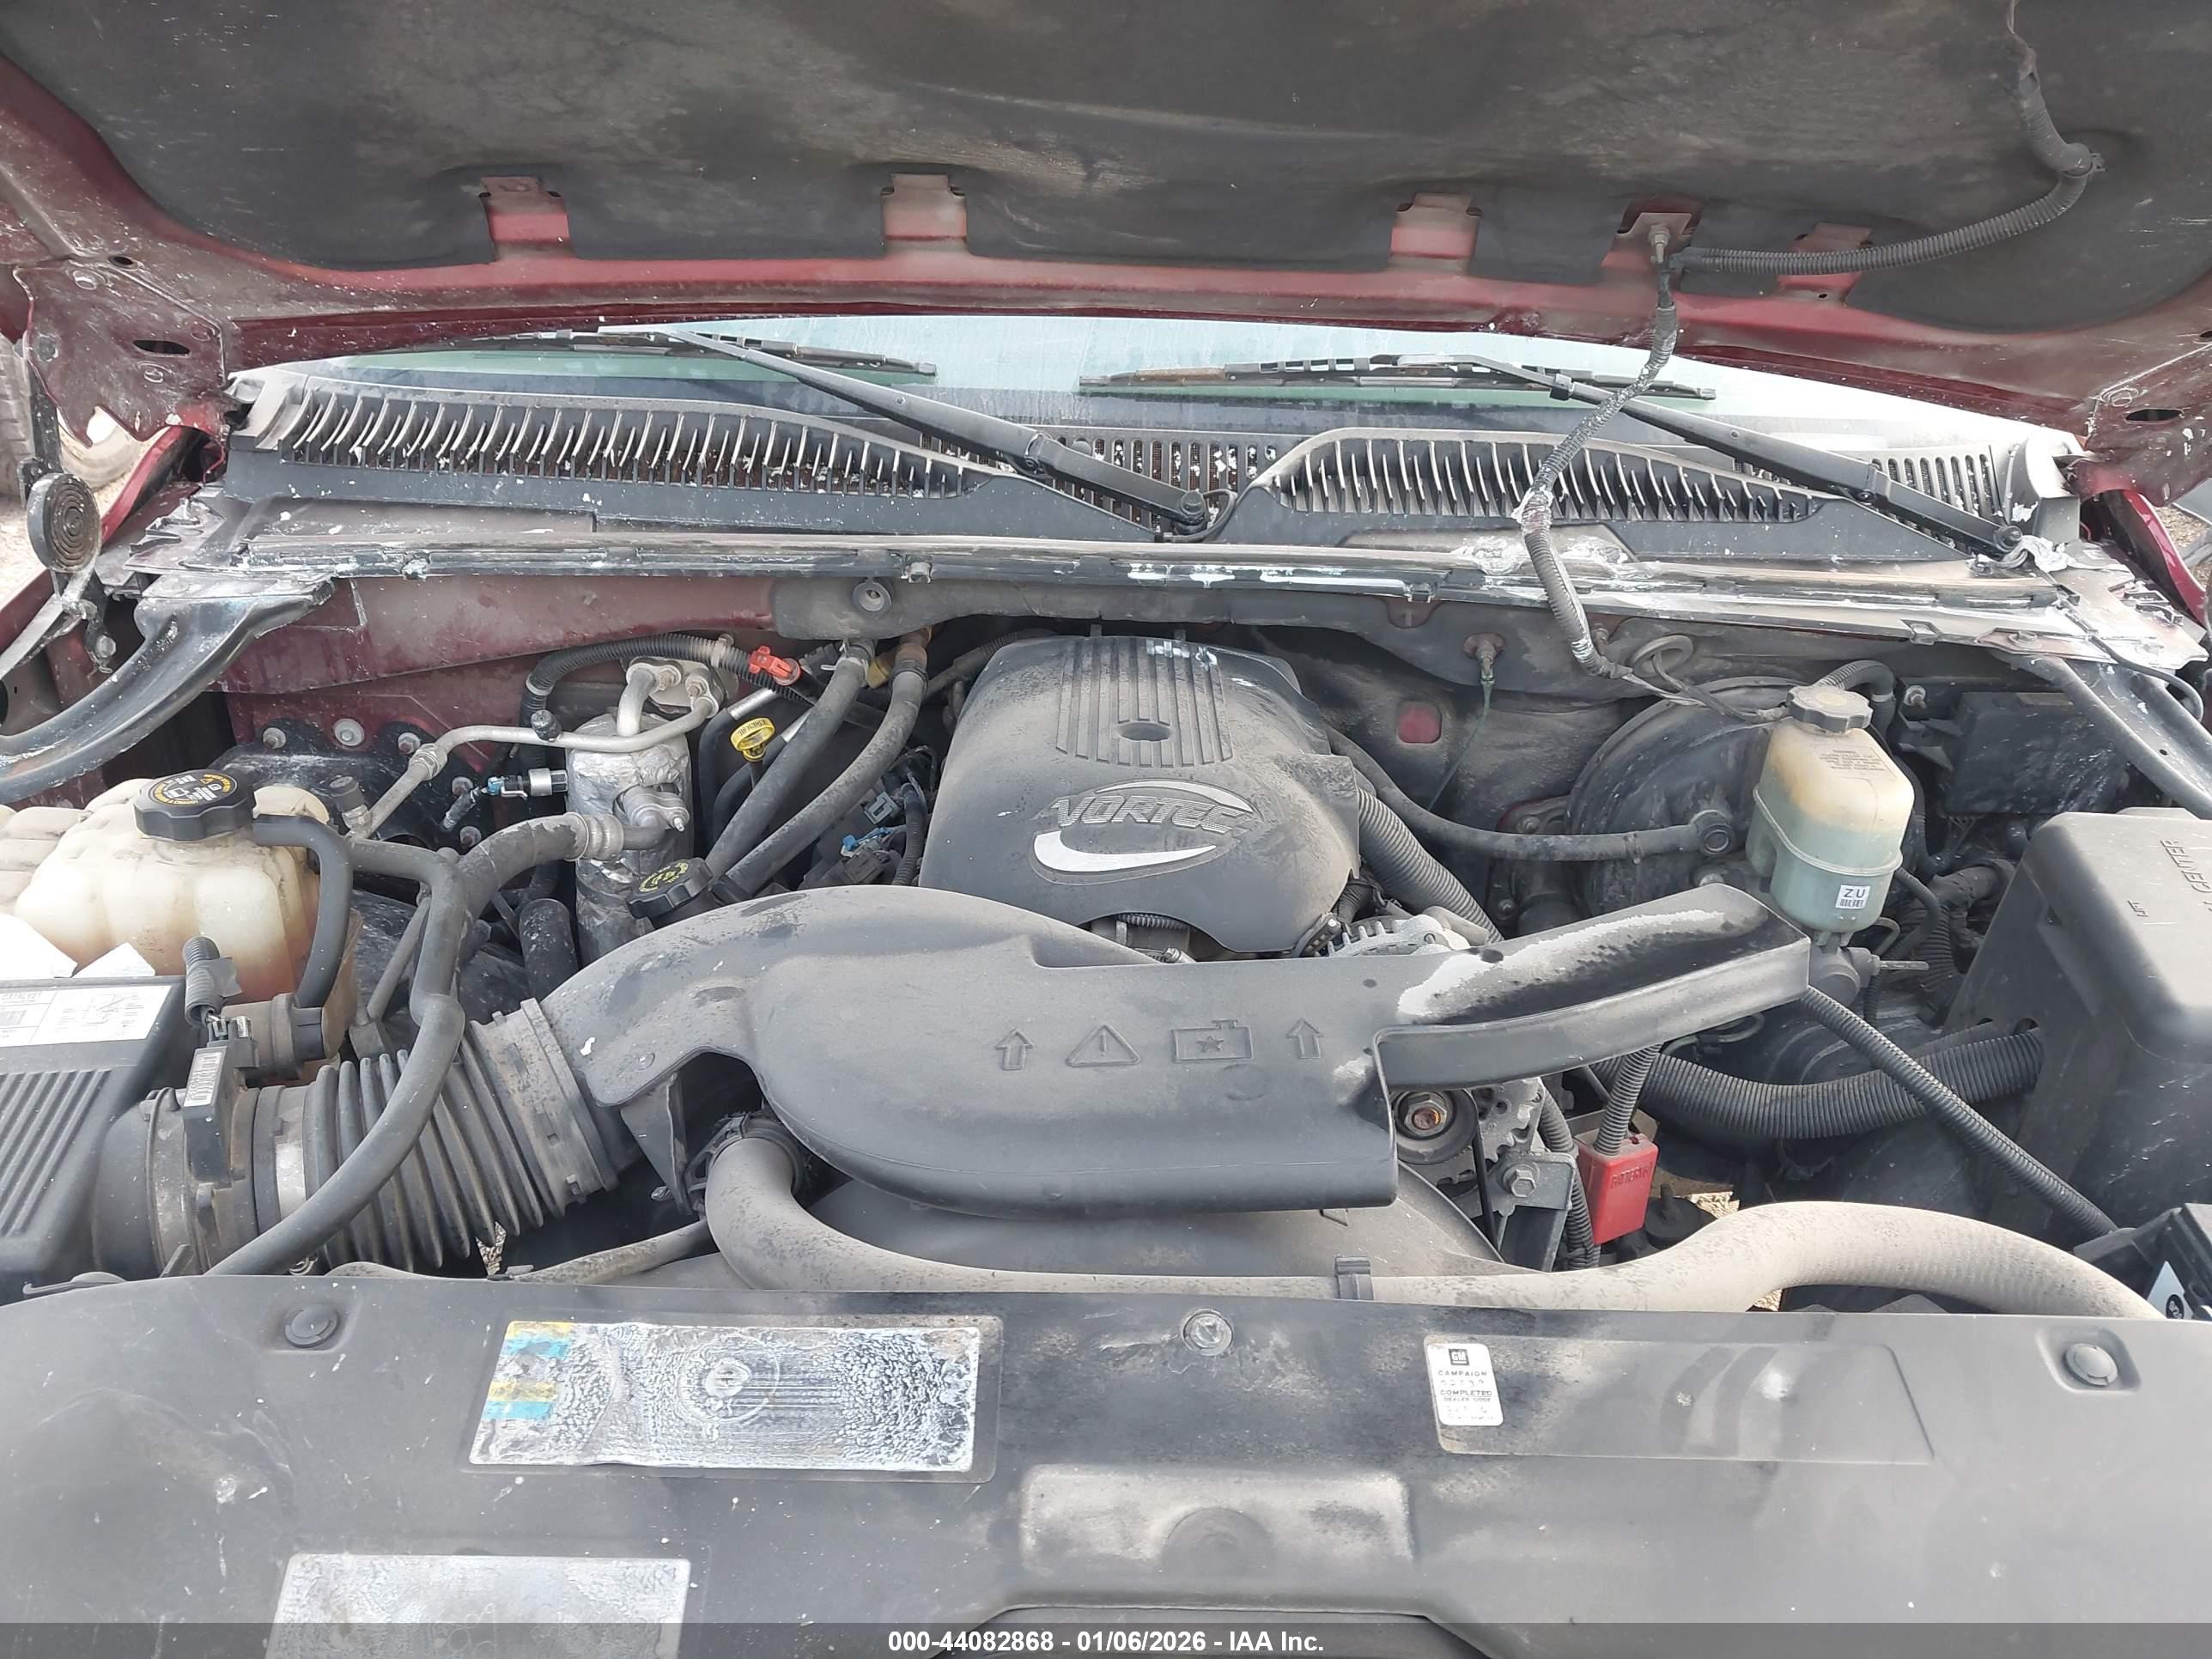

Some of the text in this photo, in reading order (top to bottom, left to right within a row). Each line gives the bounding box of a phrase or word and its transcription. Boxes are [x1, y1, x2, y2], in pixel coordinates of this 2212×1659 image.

[1050, 794, 1245, 835] VORTEC
[1843, 887, 1866, 899] ZU
[1449, 1348, 1468, 1363] GM
